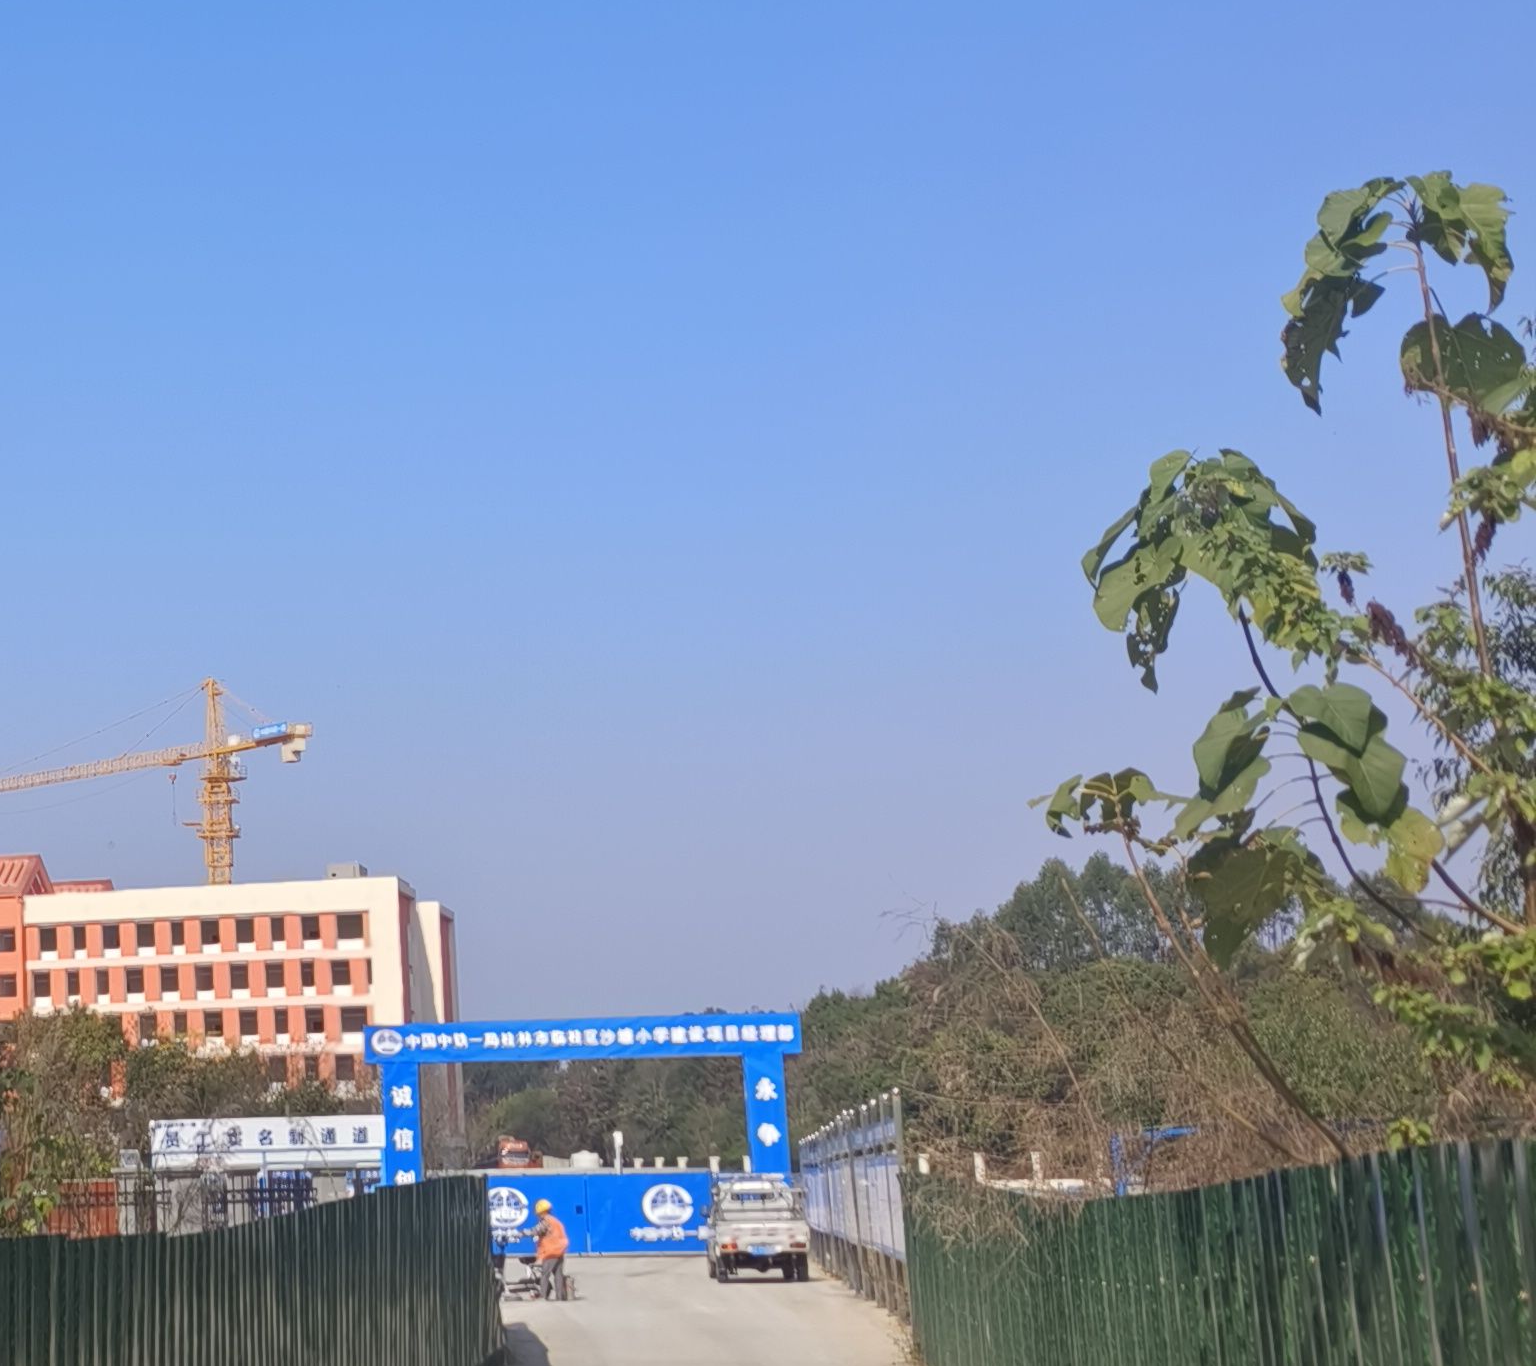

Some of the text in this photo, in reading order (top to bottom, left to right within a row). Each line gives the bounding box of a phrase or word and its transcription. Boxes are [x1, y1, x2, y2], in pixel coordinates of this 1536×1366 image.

[164, 1126, 368, 1149] 员工实名制通道
